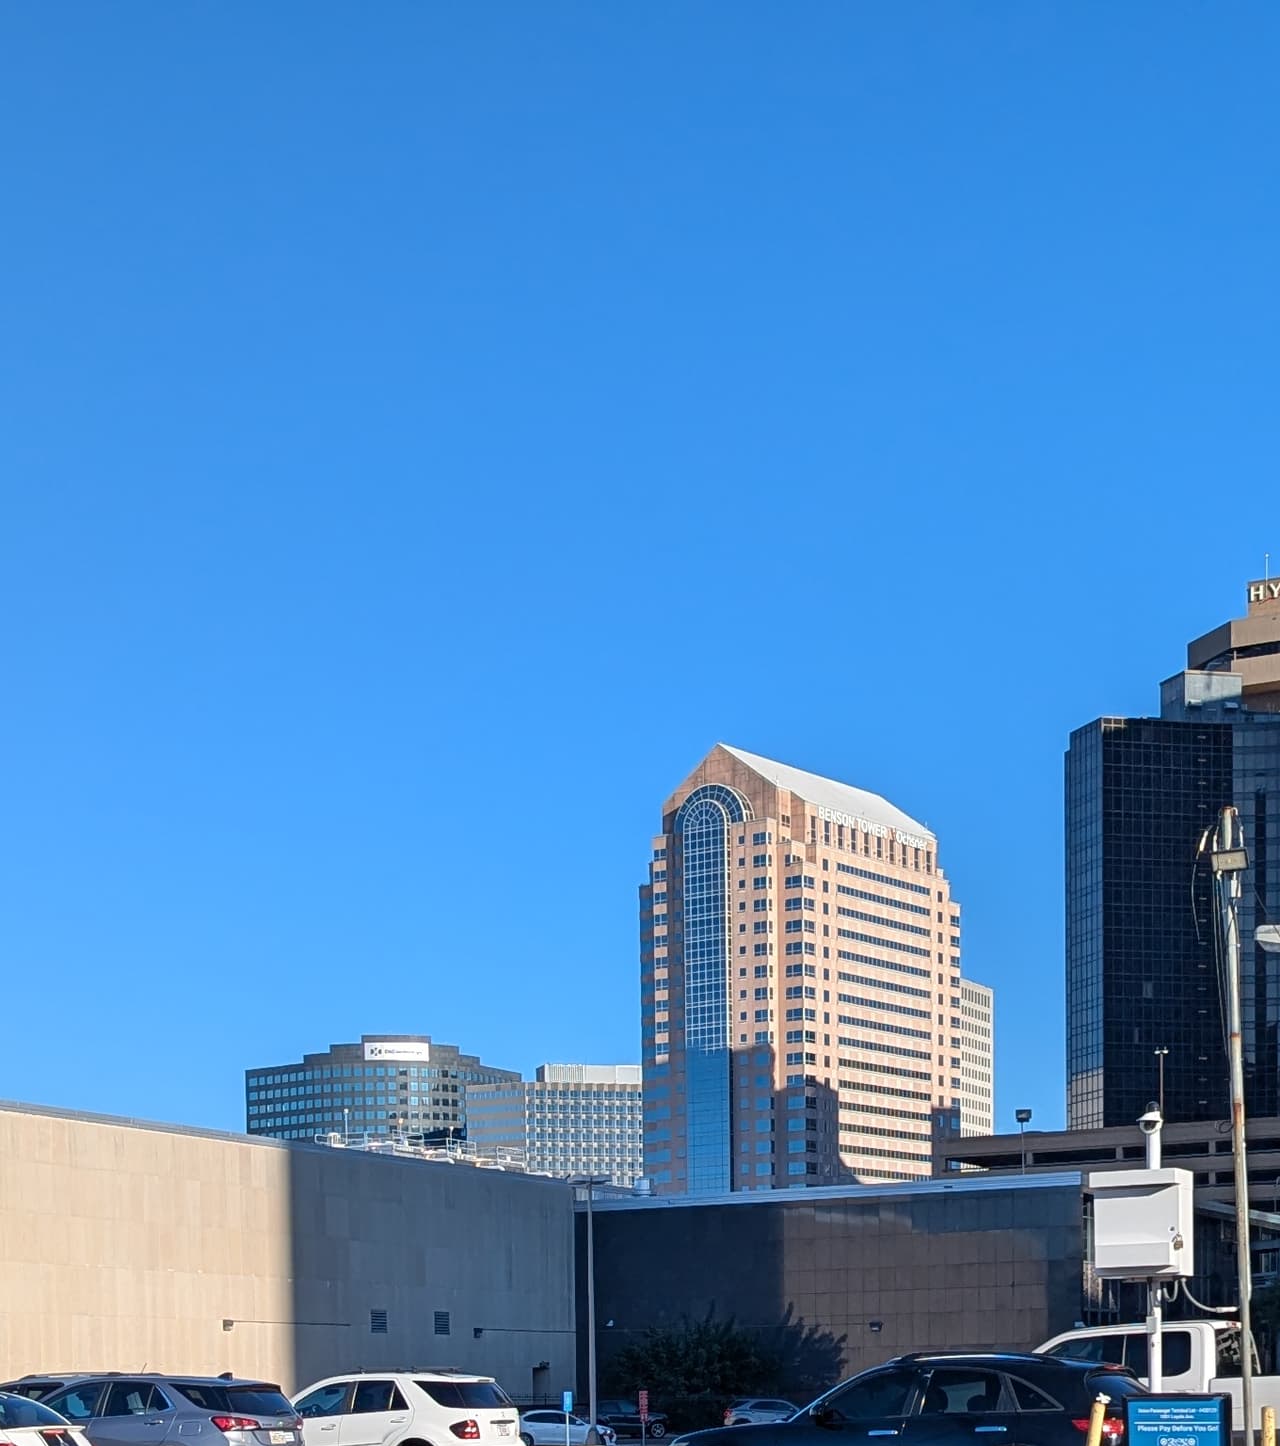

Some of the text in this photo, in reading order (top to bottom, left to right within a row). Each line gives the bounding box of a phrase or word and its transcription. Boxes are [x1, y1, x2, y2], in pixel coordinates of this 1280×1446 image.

[818, 806, 888, 839] BENSON TOWER
[1159, 1425, 1171, 1433] Pay
